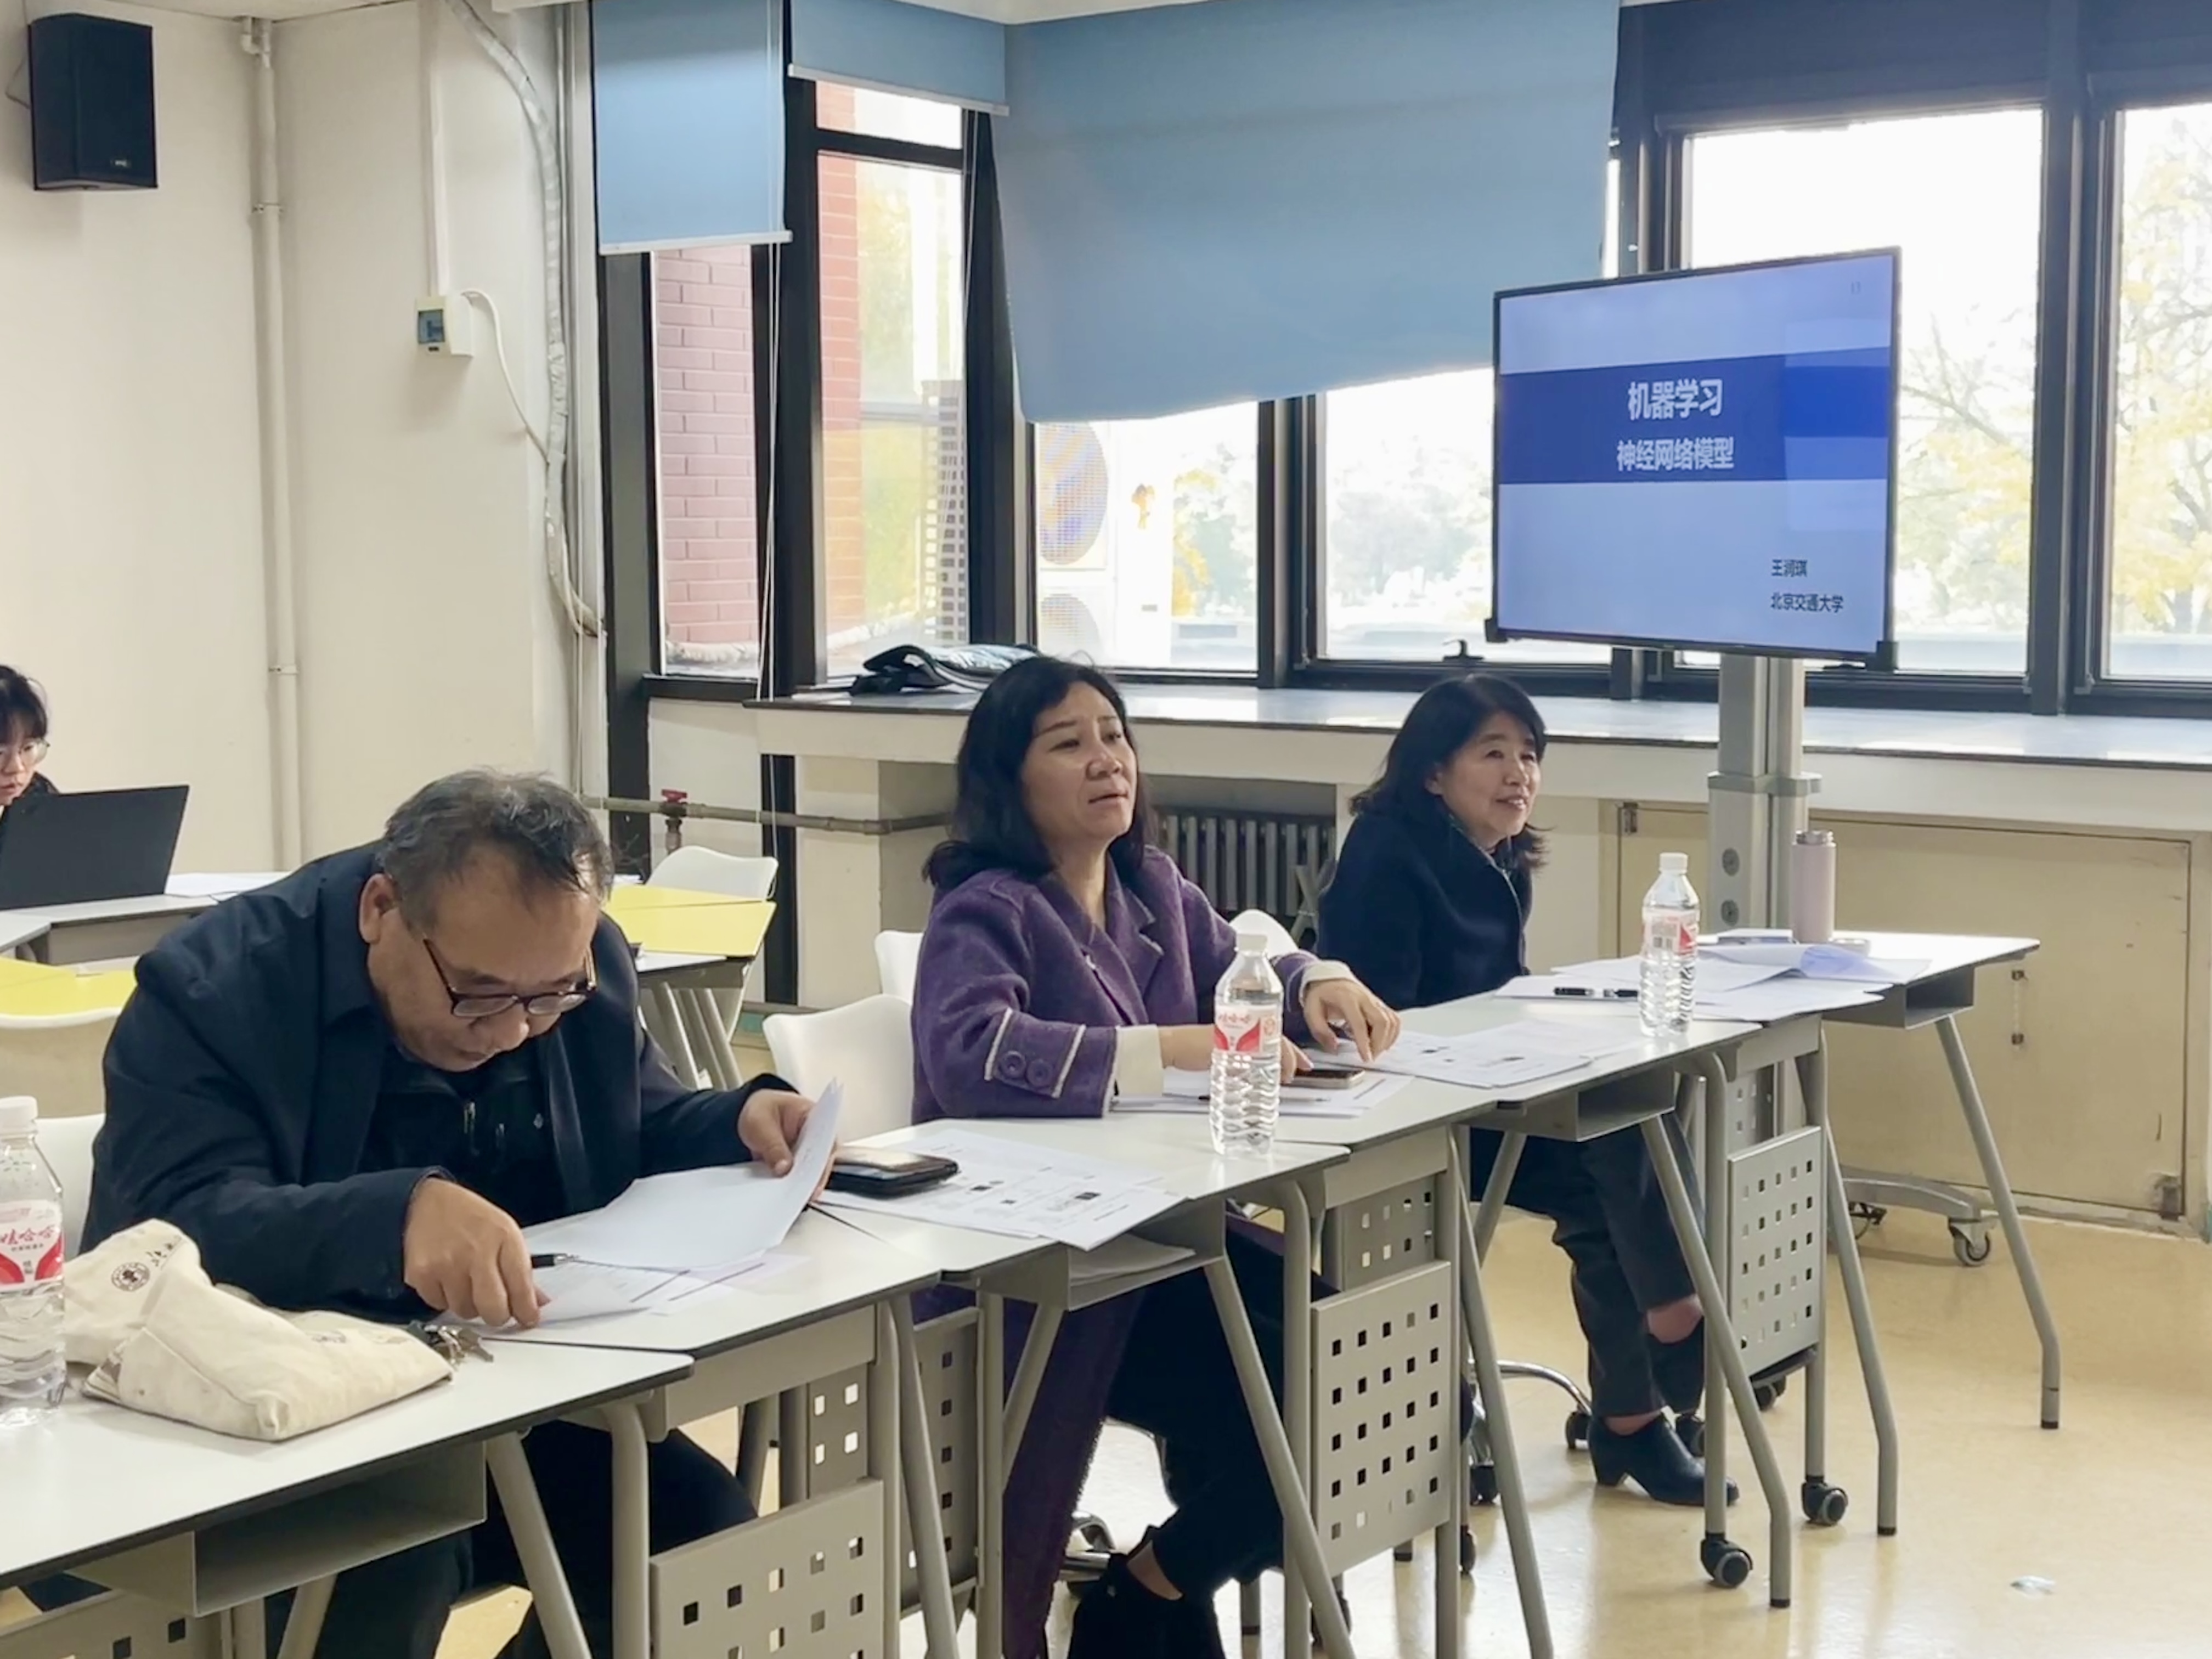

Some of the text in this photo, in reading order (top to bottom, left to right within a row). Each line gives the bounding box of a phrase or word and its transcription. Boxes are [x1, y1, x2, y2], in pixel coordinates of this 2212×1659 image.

[1628, 378, 1723, 421] 机器学习
[1616, 437, 1735, 472] 神经网络模型
[1770, 592, 1844, 613] 北京交通大学
